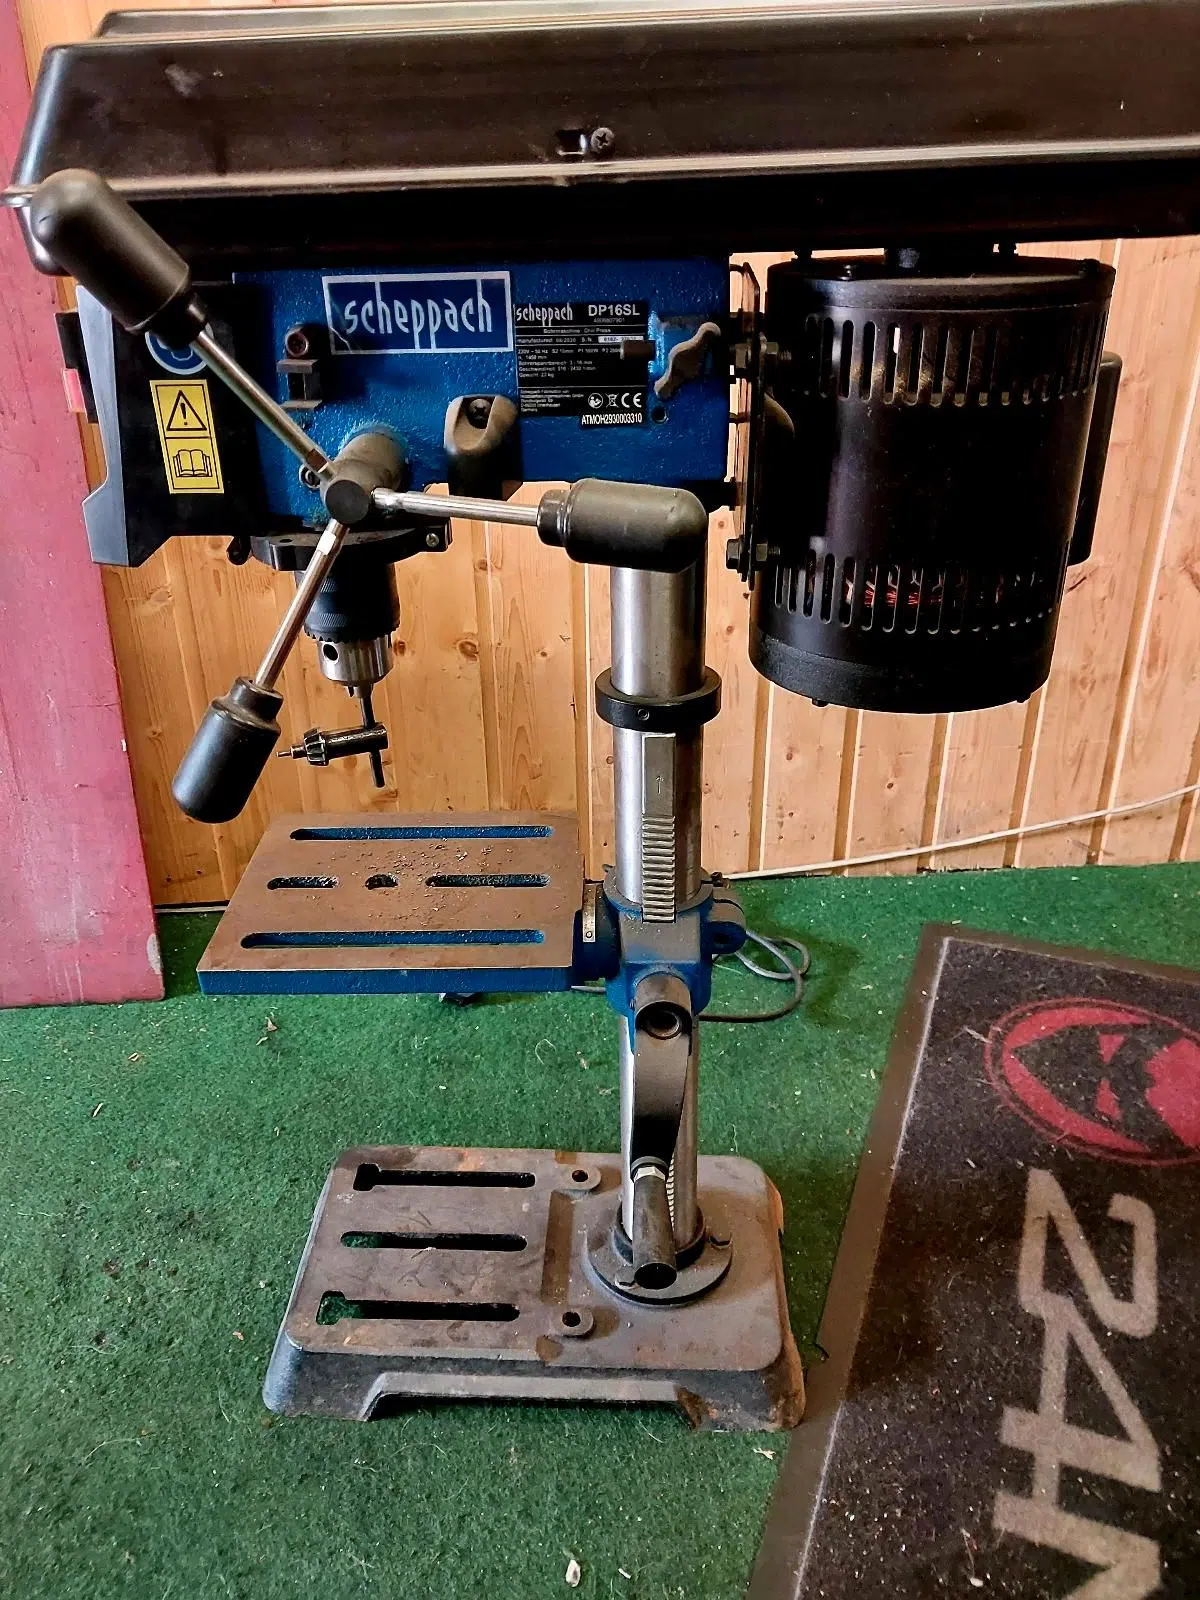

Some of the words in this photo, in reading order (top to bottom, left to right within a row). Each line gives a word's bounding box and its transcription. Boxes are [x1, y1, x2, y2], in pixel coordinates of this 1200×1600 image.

[344, 280, 493, 349] scheppach
[516, 302, 573, 327] scheppach
[588, 304, 640, 316] DP16SL
